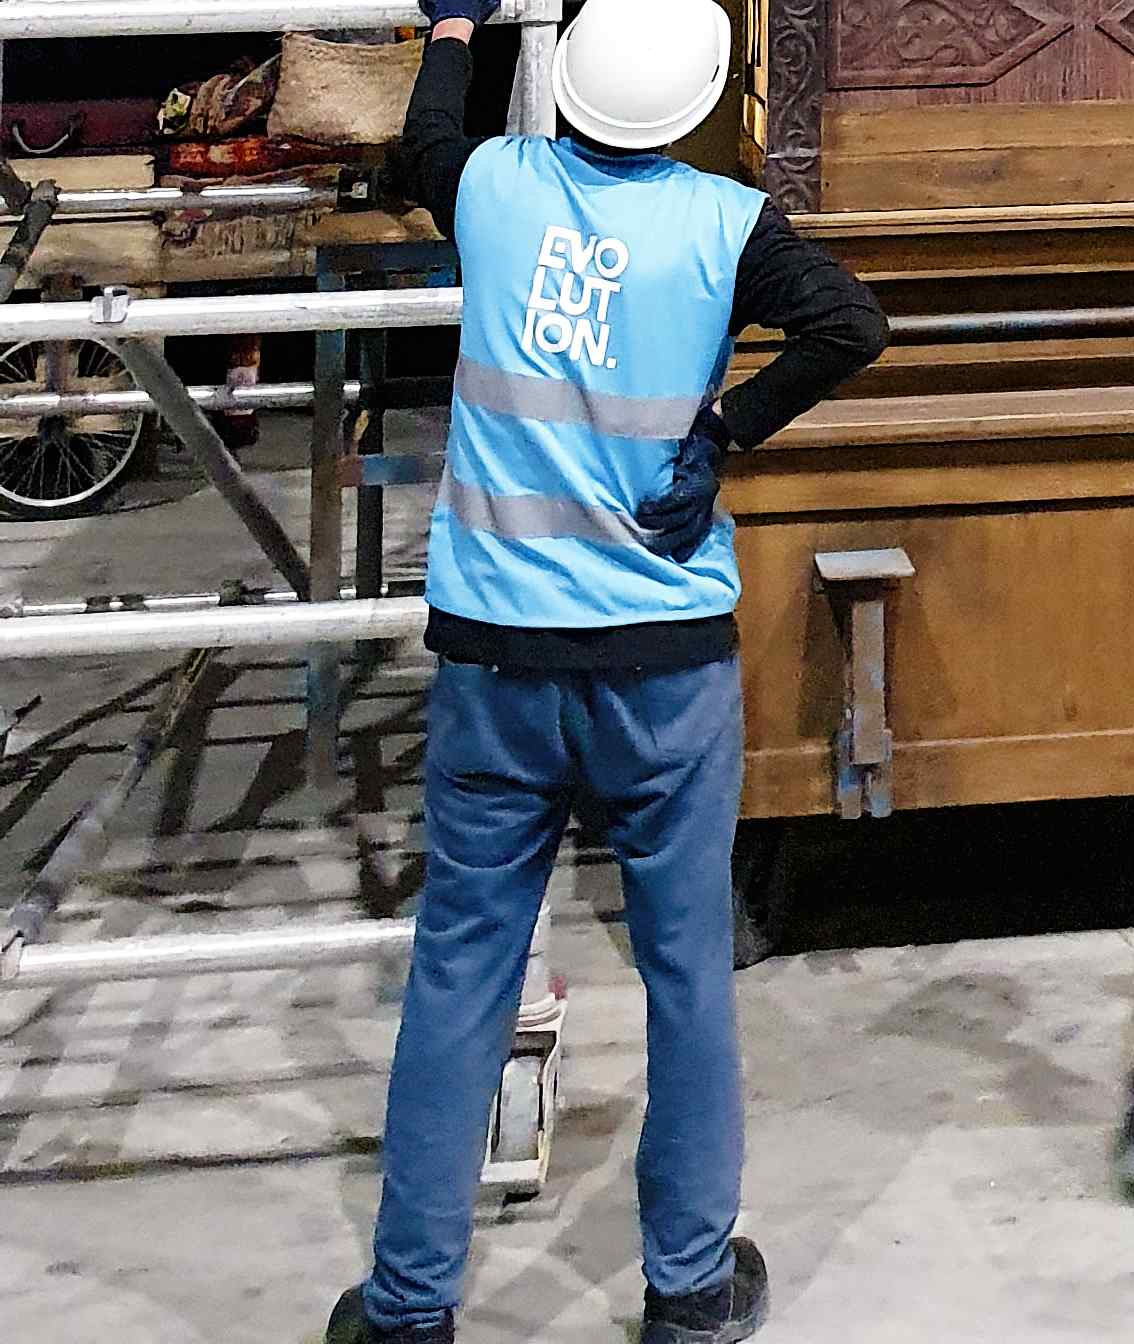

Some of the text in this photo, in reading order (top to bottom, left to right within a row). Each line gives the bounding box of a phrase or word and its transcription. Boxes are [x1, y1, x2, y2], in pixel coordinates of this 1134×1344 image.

[538, 225, 629, 279] EVO
[528, 265, 623, 322] LUT
[521, 308, 617, 369] ION.
